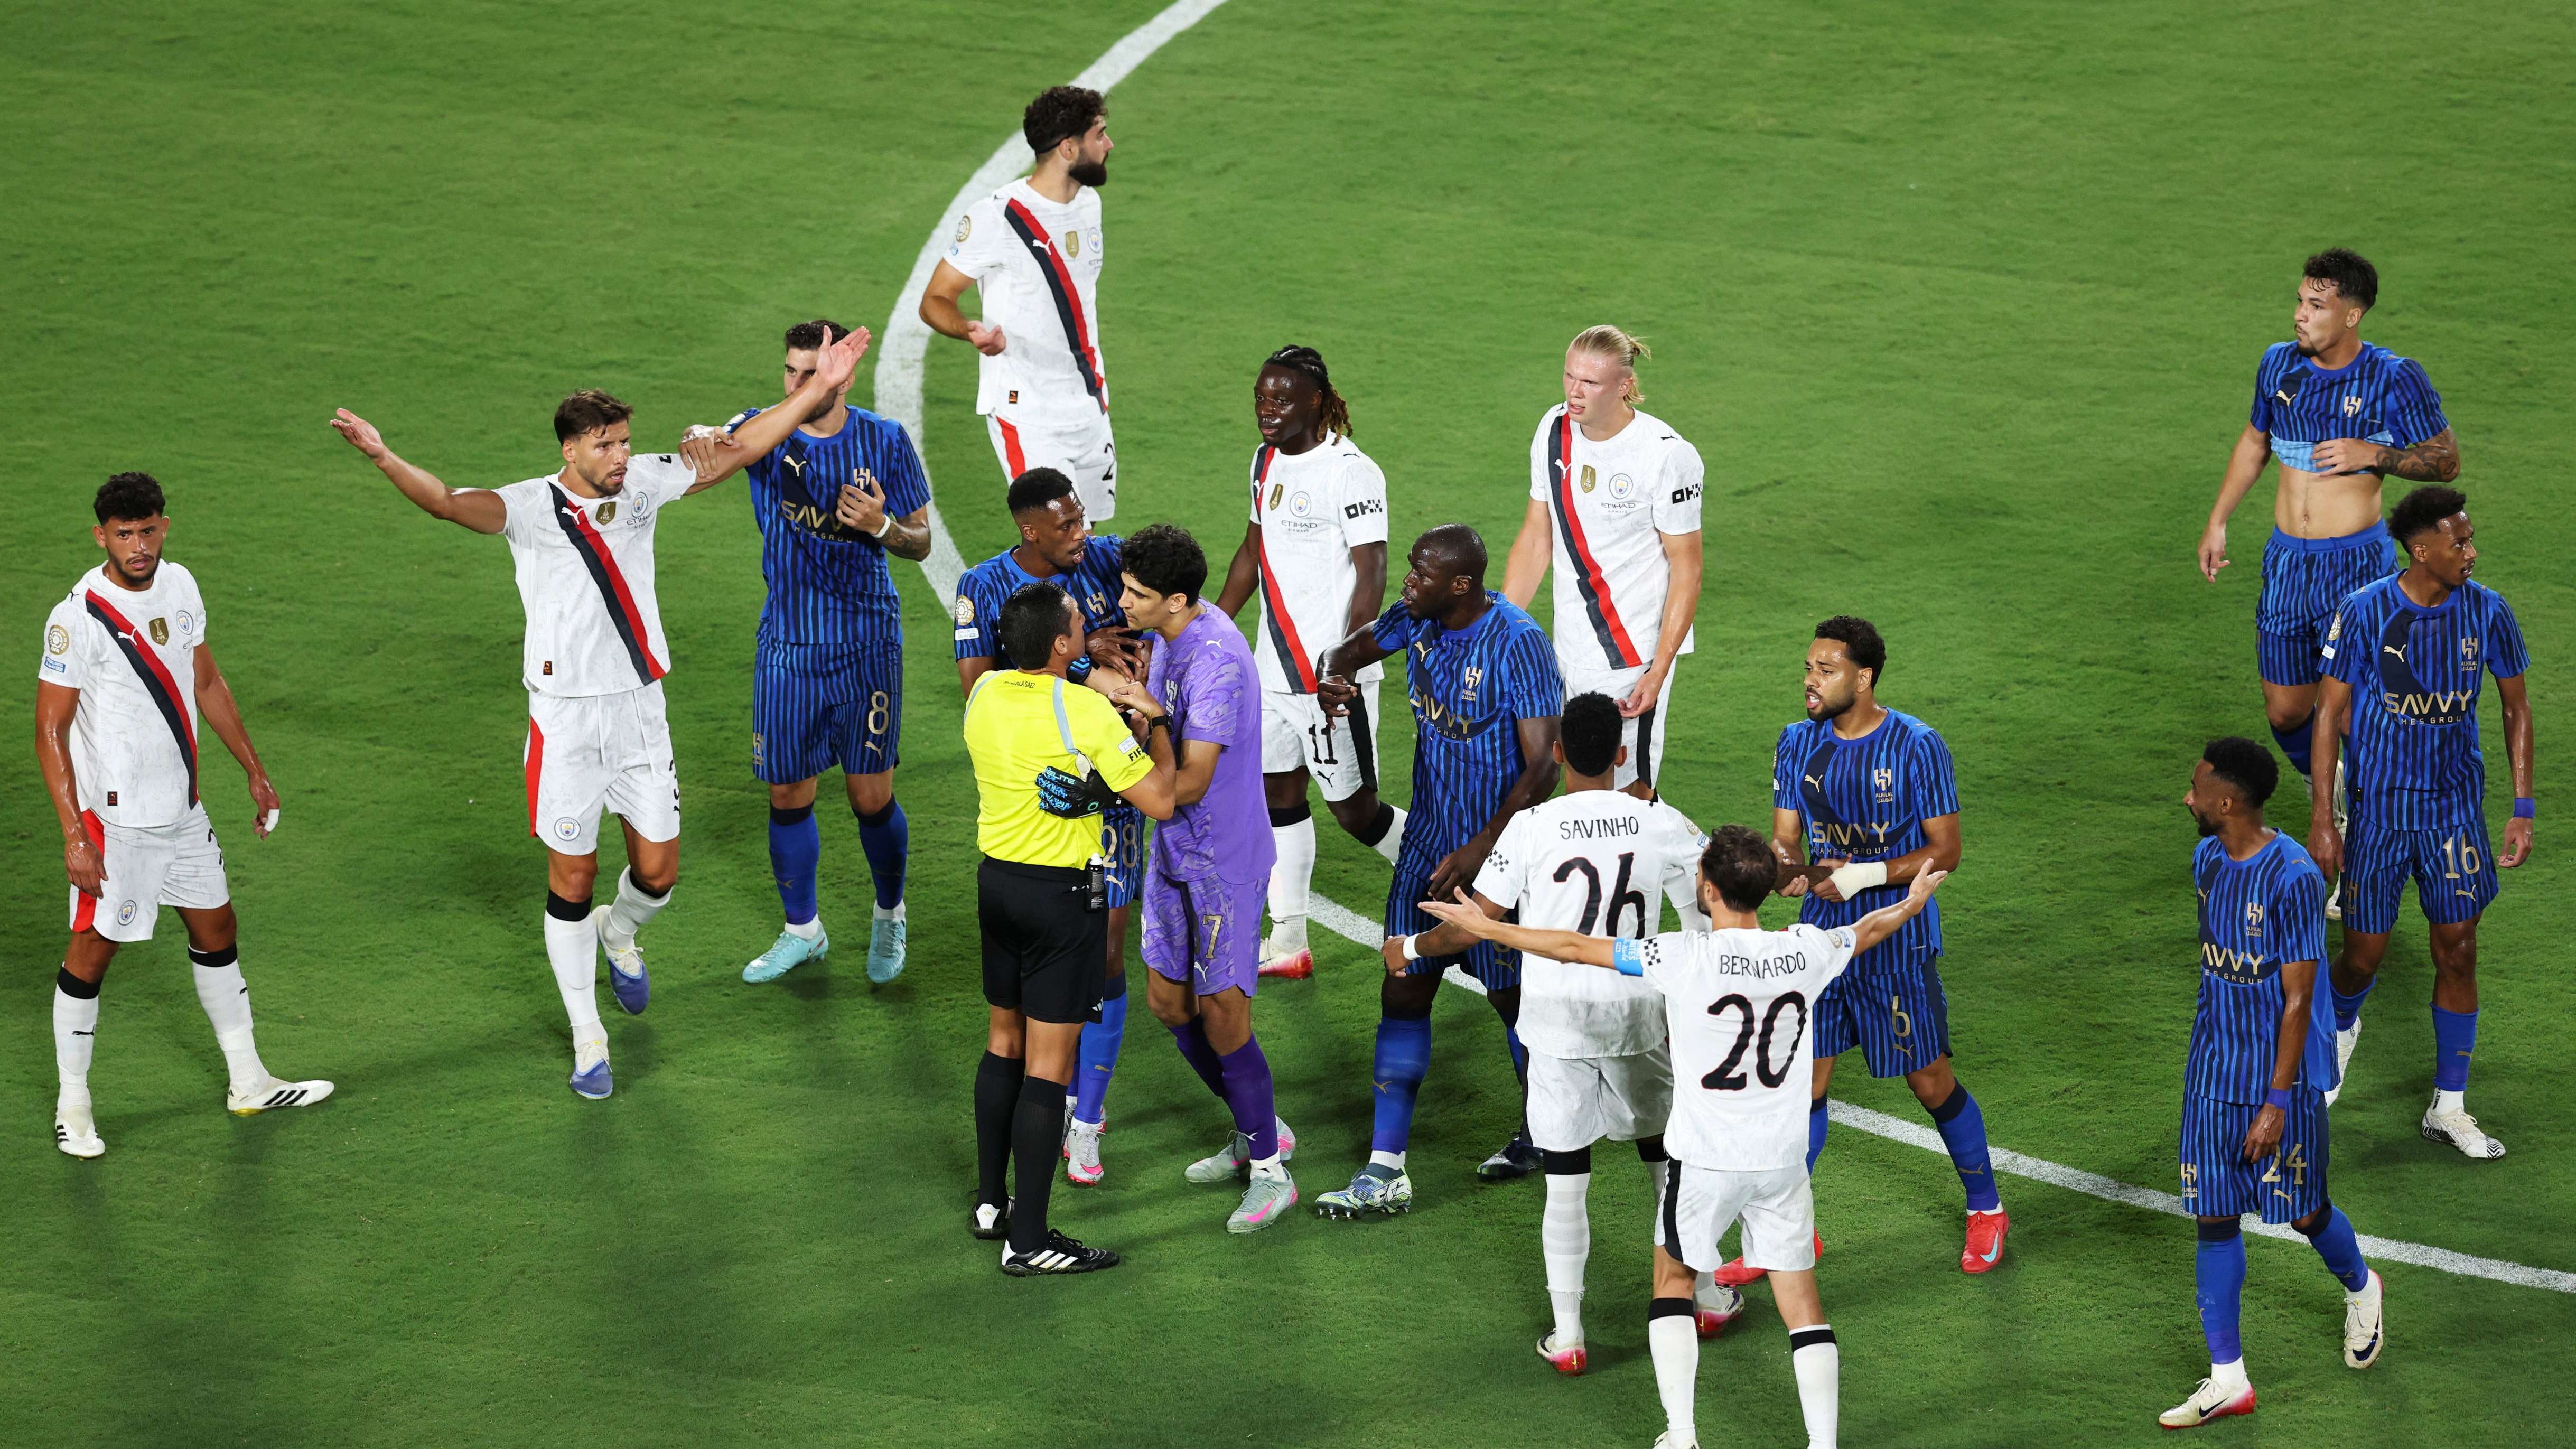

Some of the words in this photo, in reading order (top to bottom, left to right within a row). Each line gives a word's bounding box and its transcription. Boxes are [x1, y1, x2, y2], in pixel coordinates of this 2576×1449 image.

[781, 500, 844, 532] SAVV
[1281, 520, 1318, 528] ETIHAD
[868, 691, 889, 735] 8
[1410, 684, 1475, 734] SAVVY
[2384, 689, 2472, 715] SAVVY
[2430, 715, 2461, 724] GROU
[1309, 723, 1338, 765] 11
[1559, 816, 1639, 840] SAVINHO
[1812, 821, 1890, 845] SAVVY
[1102, 824, 1138, 869] 28
[1853, 846, 1889, 855] GROUP
[2442, 831, 2480, 879] 16
[1552, 851, 1646, 940] 26
[1719, 951, 1806, 979] BERNARDO
[2202, 942, 2264, 975] AVVY
[2224, 973, 2263, 985] GROUP
[1891, 995, 1910, 1037] 6
[1701, 990, 1808, 1091] 20
[2261, 1143, 2307, 1185] 24
